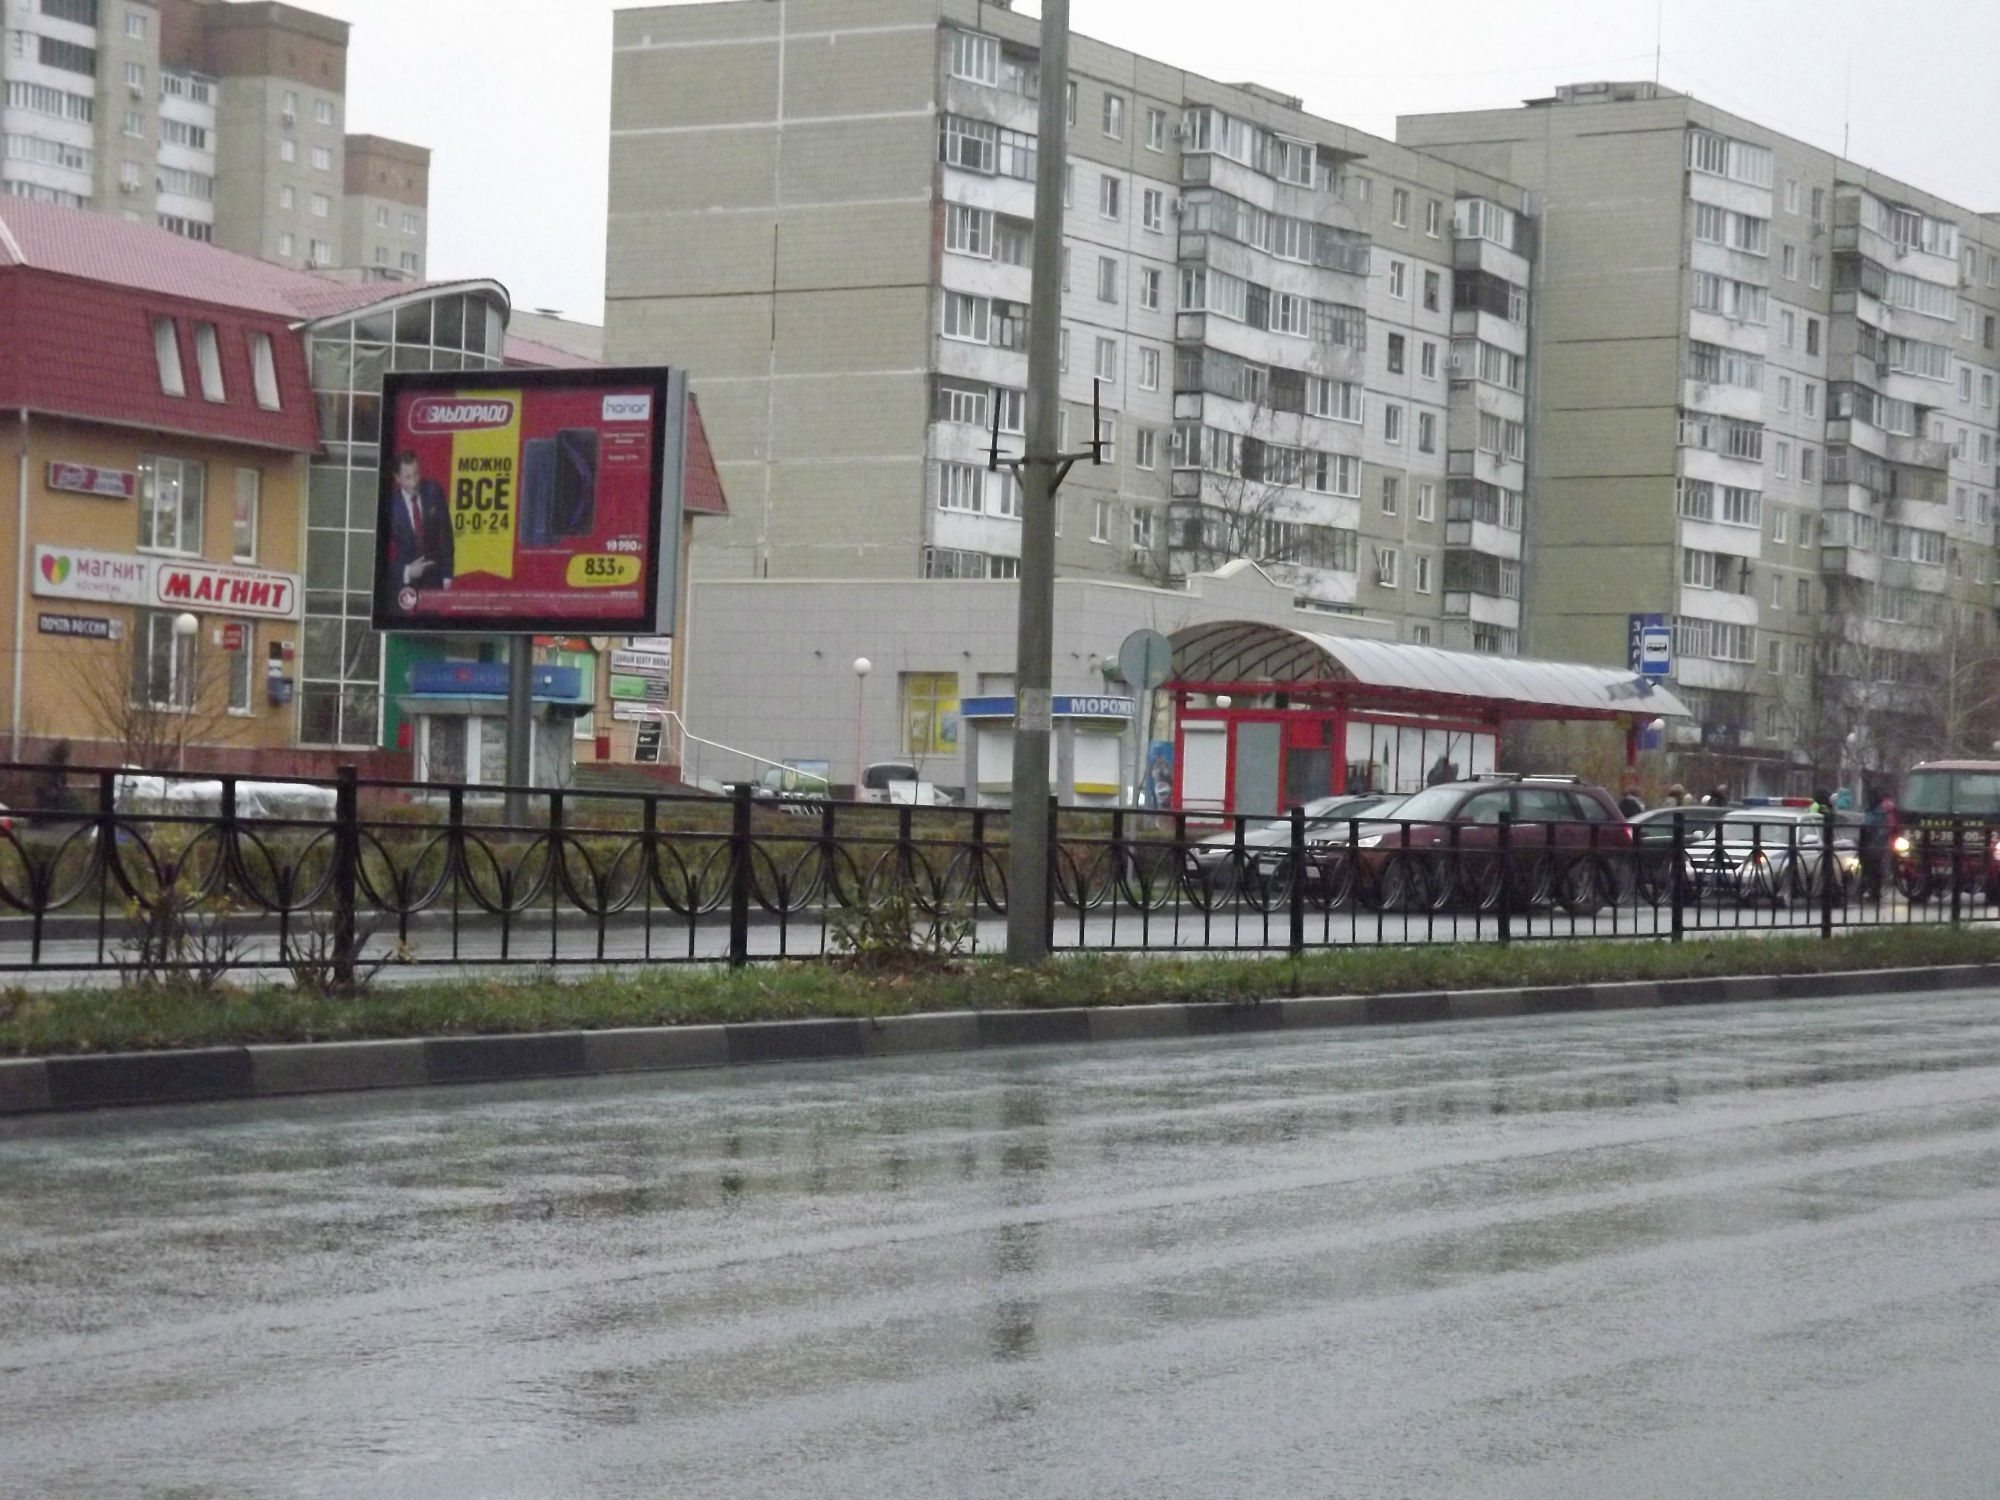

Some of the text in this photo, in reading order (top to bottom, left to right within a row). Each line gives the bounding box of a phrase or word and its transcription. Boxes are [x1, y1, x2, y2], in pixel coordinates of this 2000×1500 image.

[458, 457, 512, 472] МОЖНО
[455, 472, 511, 511] ВСЁ
[584, 558, 615, 576] 833
[164, 572, 287, 608] МАГНИТ
[72, 619, 107, 636] РОССИИ
